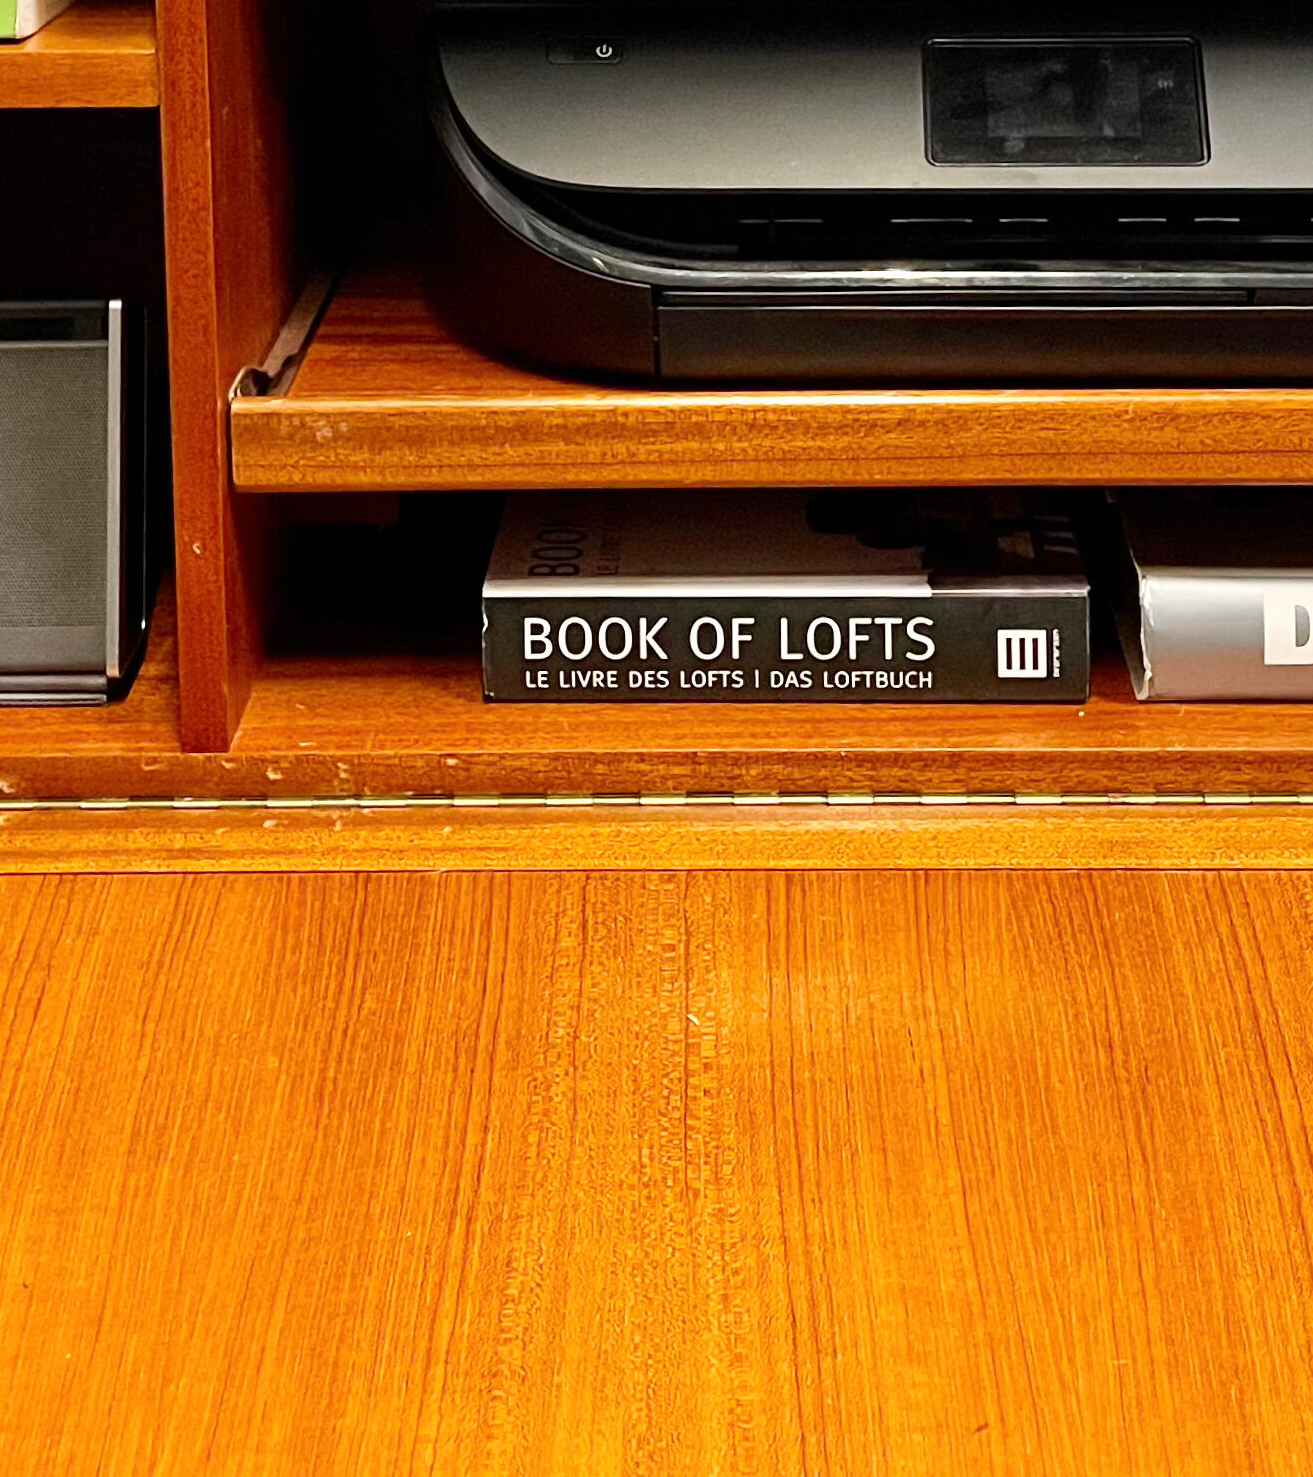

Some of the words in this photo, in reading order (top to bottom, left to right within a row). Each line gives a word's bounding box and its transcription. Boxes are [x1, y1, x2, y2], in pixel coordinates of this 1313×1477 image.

[524, 616, 668, 660] BOOK
[689, 616, 755, 660] OF
[780, 616, 935, 661] LOFTS
[525, 670, 550, 689] LE
[559, 670, 619, 689] LIVRE
[628, 670, 670, 689] DES
[680, 670, 744, 689] LOFTS
[770, 670, 813, 689] DAS
[823, 670, 932, 689] LOFTBUCH
